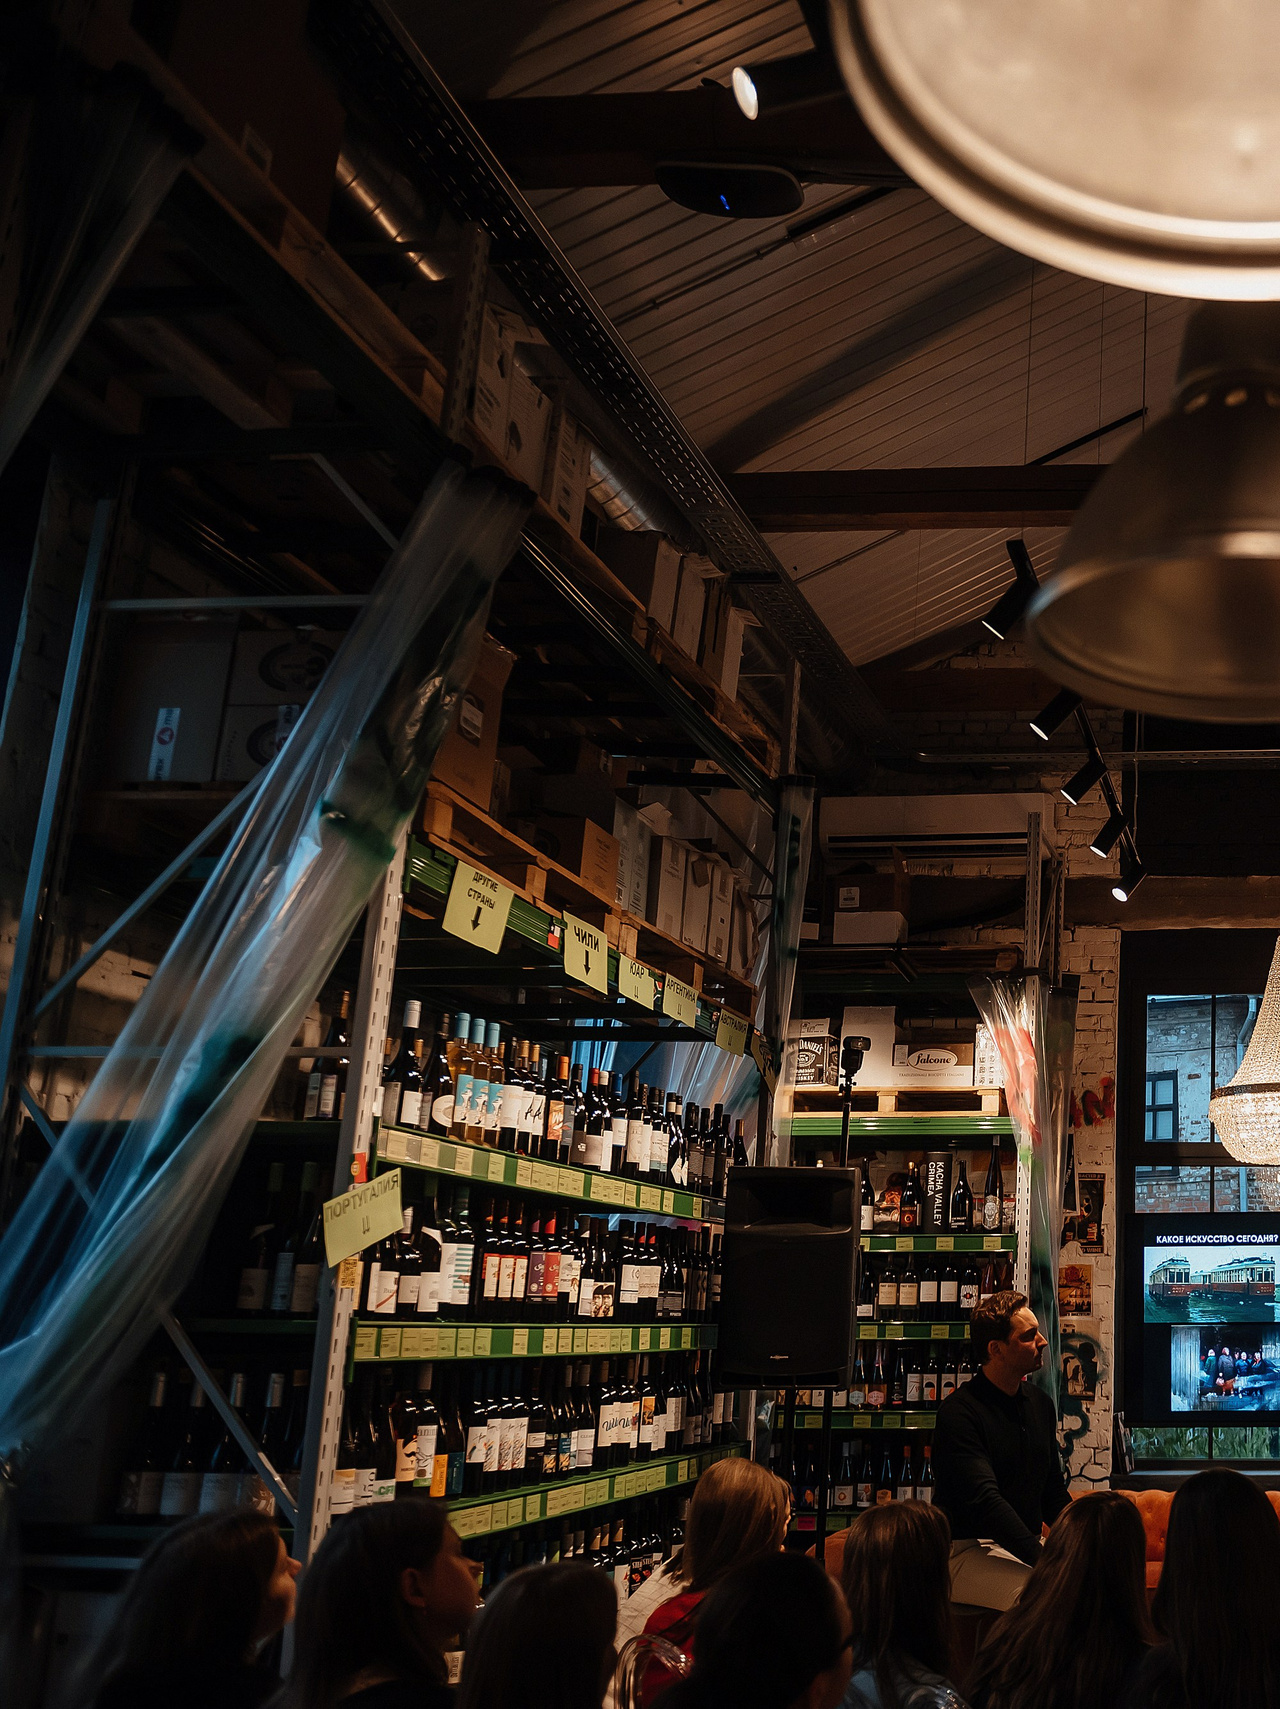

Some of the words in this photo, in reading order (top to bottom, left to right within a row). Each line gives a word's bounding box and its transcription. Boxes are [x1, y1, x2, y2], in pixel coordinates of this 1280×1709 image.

[472, 871, 499, 893] ДРУГИЕ
[467, 887, 496, 910] СТРАНЫ
[574, 925, 600, 953] ЧИЛИ
[629, 960, 645, 979] ЮАР
[666, 979, 697, 1004] АРГЕНТИНА
[720, 1012, 748, 1034] АВСТРАЛИЯ
[914, 1053, 952, 1066] falcone
[927, 1161, 936, 1197] CRIMEA
[935, 1161, 945, 1191] KACHA
[325, 1173, 400, 1223] ПОРТУГАЛИЯ
[933, 1192, 943, 1226] VALLEY
[1156, 1235, 1184, 1244] КАКОЕ
[1185, 1235, 1235, 1244] ИСКУССТВО
[1236, 1234, 1279, 1244] СЕГОДНЯ?
